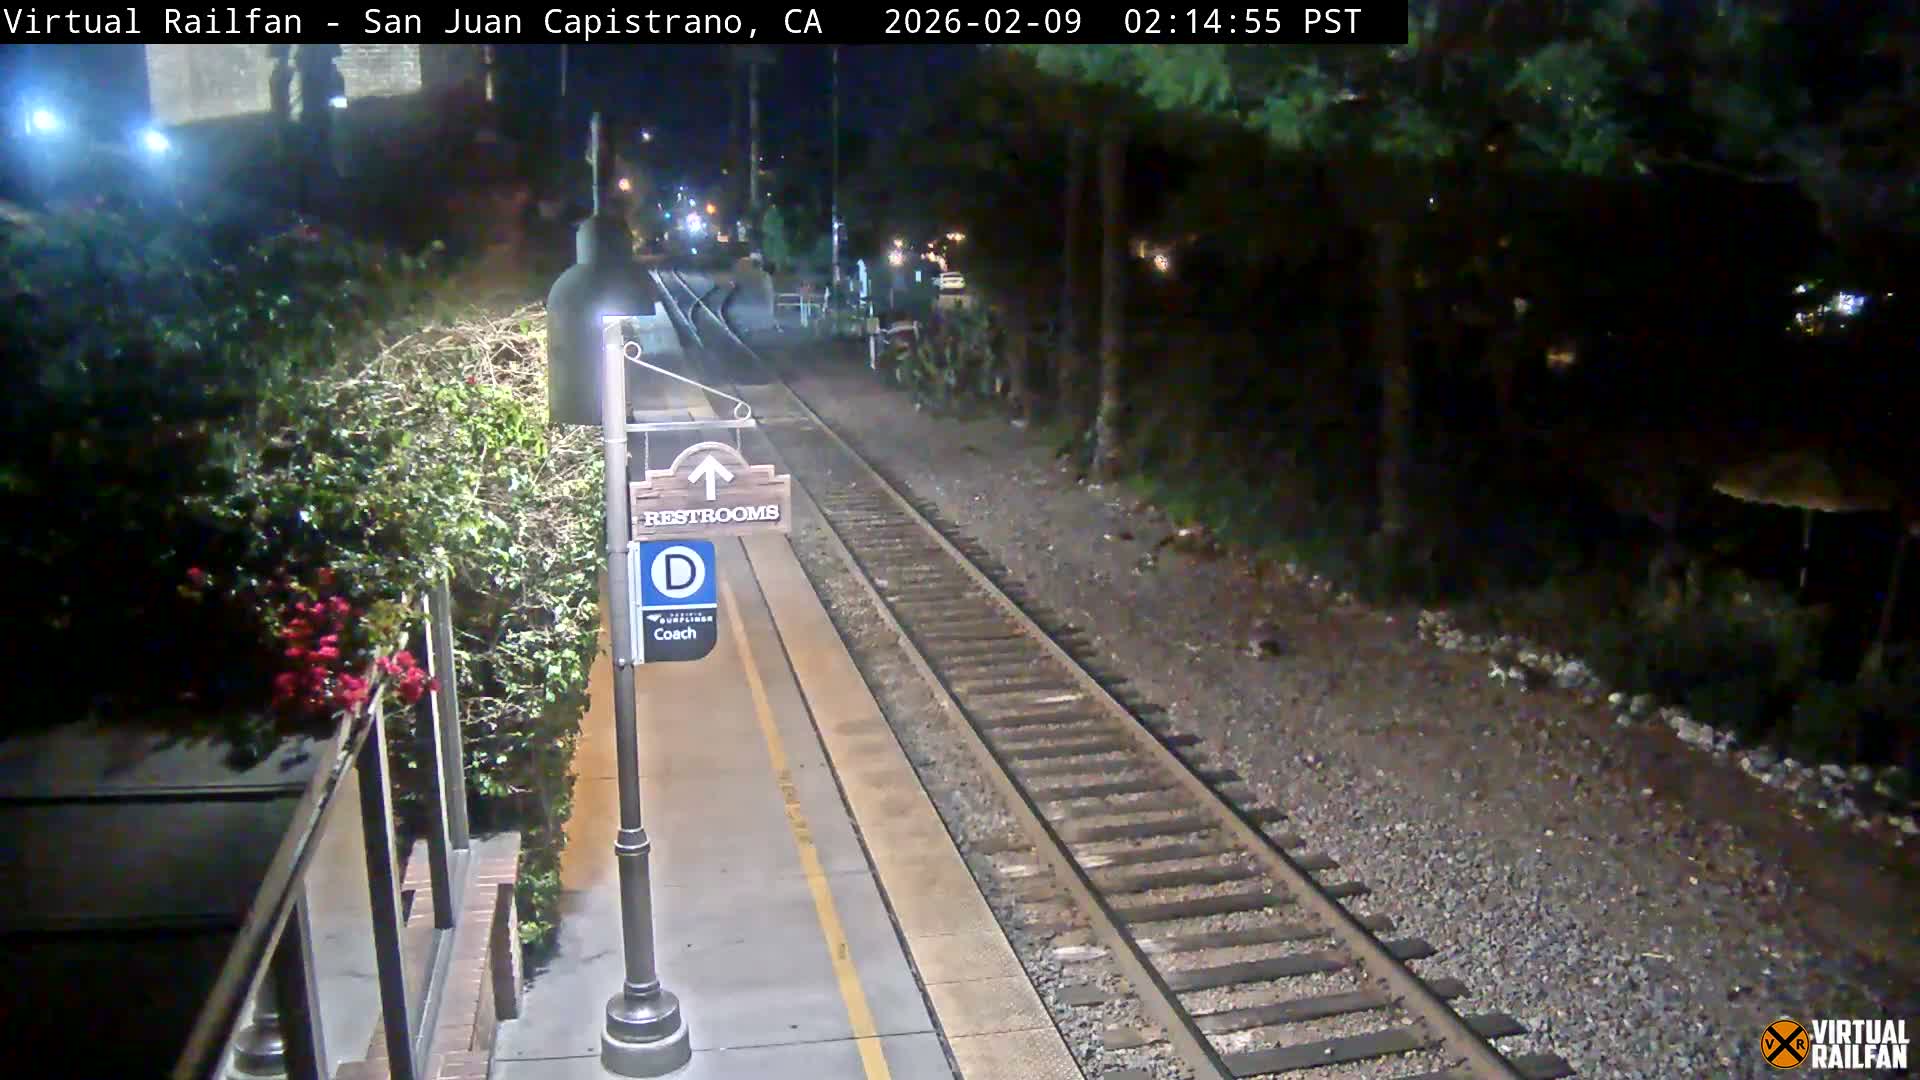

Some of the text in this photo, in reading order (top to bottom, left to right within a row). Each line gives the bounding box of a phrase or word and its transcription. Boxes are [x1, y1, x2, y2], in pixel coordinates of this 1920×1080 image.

[643, 504, 780, 527] RESTROOMS
[665, 553, 697, 591] D
[654, 625, 697, 641] Coach
